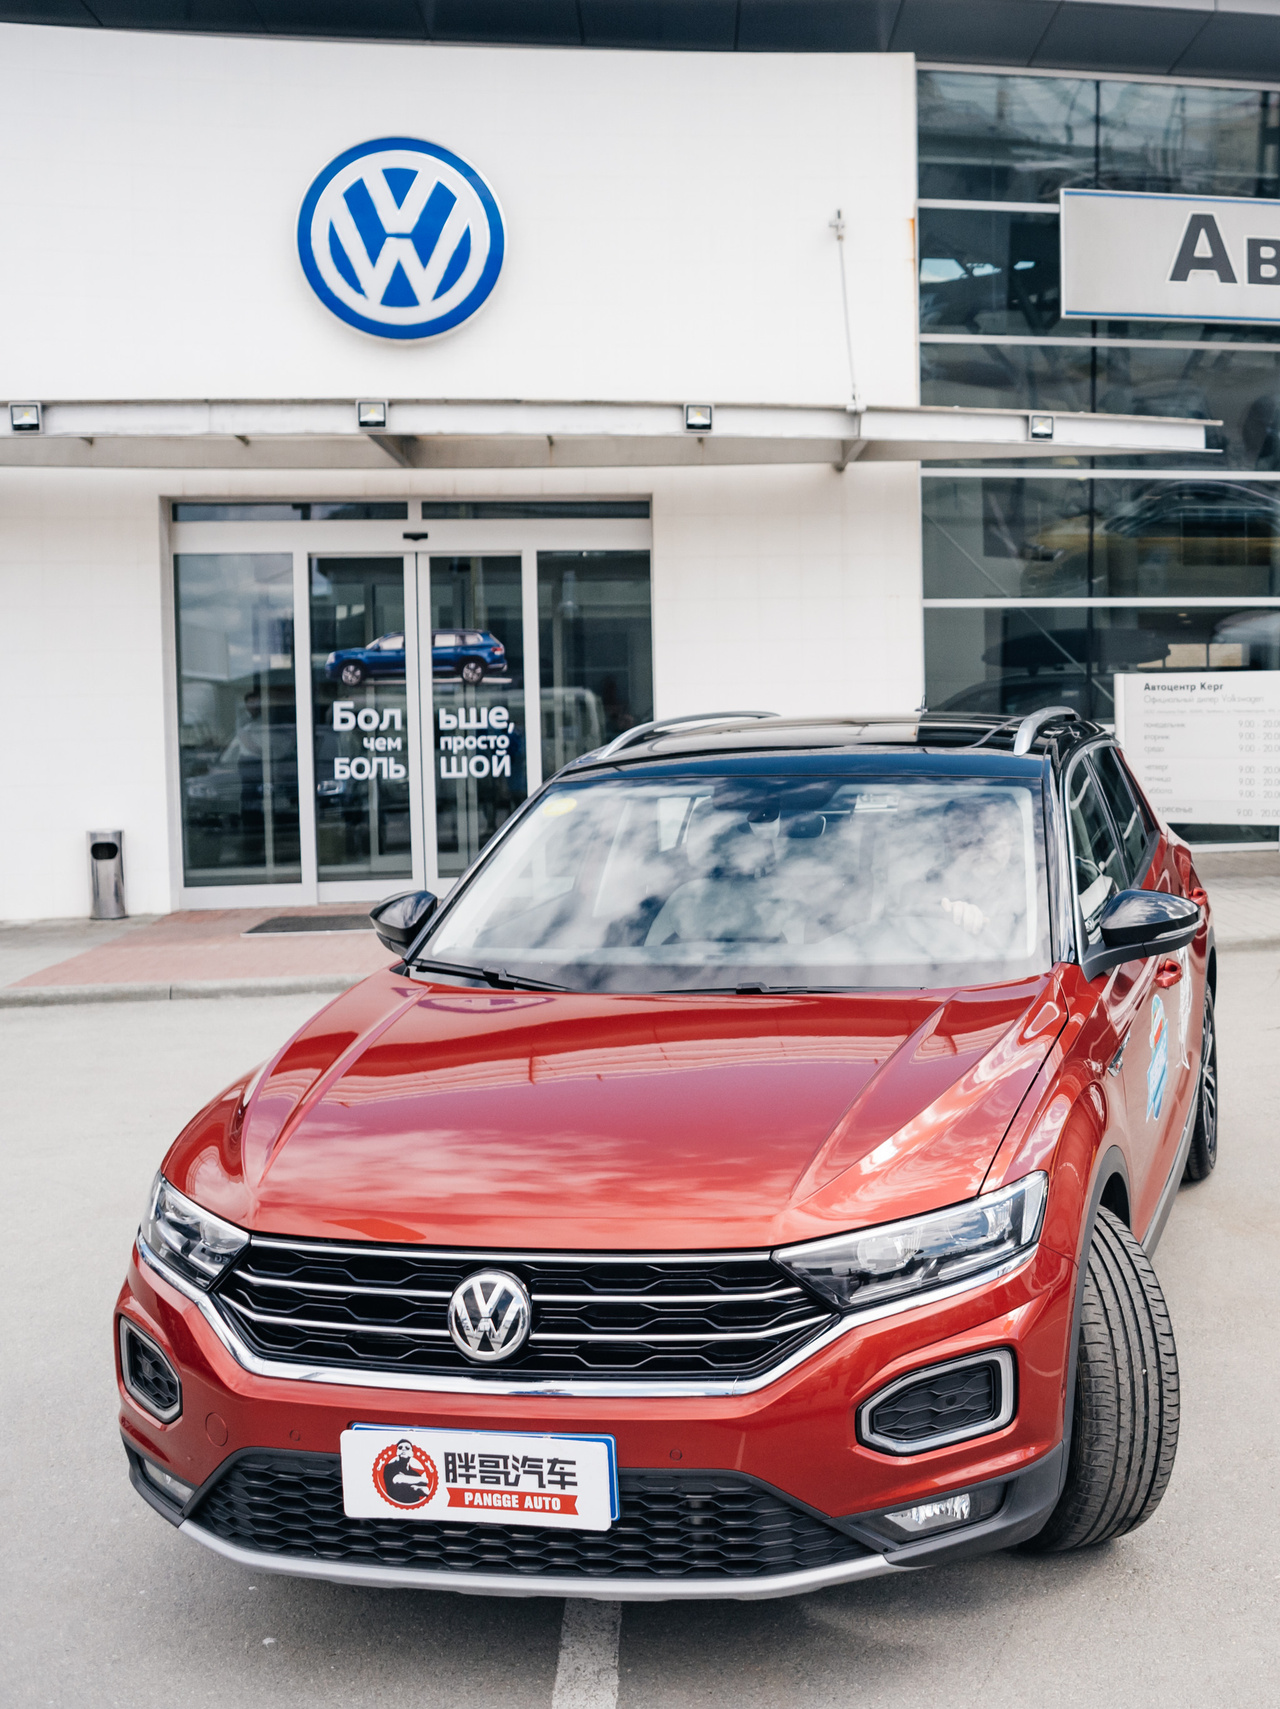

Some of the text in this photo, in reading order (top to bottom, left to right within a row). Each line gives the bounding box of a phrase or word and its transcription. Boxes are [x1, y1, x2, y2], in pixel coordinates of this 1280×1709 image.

[1143, 682, 1224, 693] Автоцентр Керг
[1221, 694, 1264, 705] Volkswagen
[1238, 720, 1255, 729] 9.00
[1238, 732, 1255, 741] 9.00
[363, 734, 510, 754] чем просто
[1238, 744, 1255, 753] 9.00
[1238, 766, 1255, 775] 9.00
[1238, 778, 1255, 787] 9.00
[1238, 791, 1255, 799] 9.00
[1236, 808, 1253, 817] 9.00
[443, 1451, 578, 1490] 胖哥汽车
[464, 1491, 562, 1511] PANGGE AUTO
